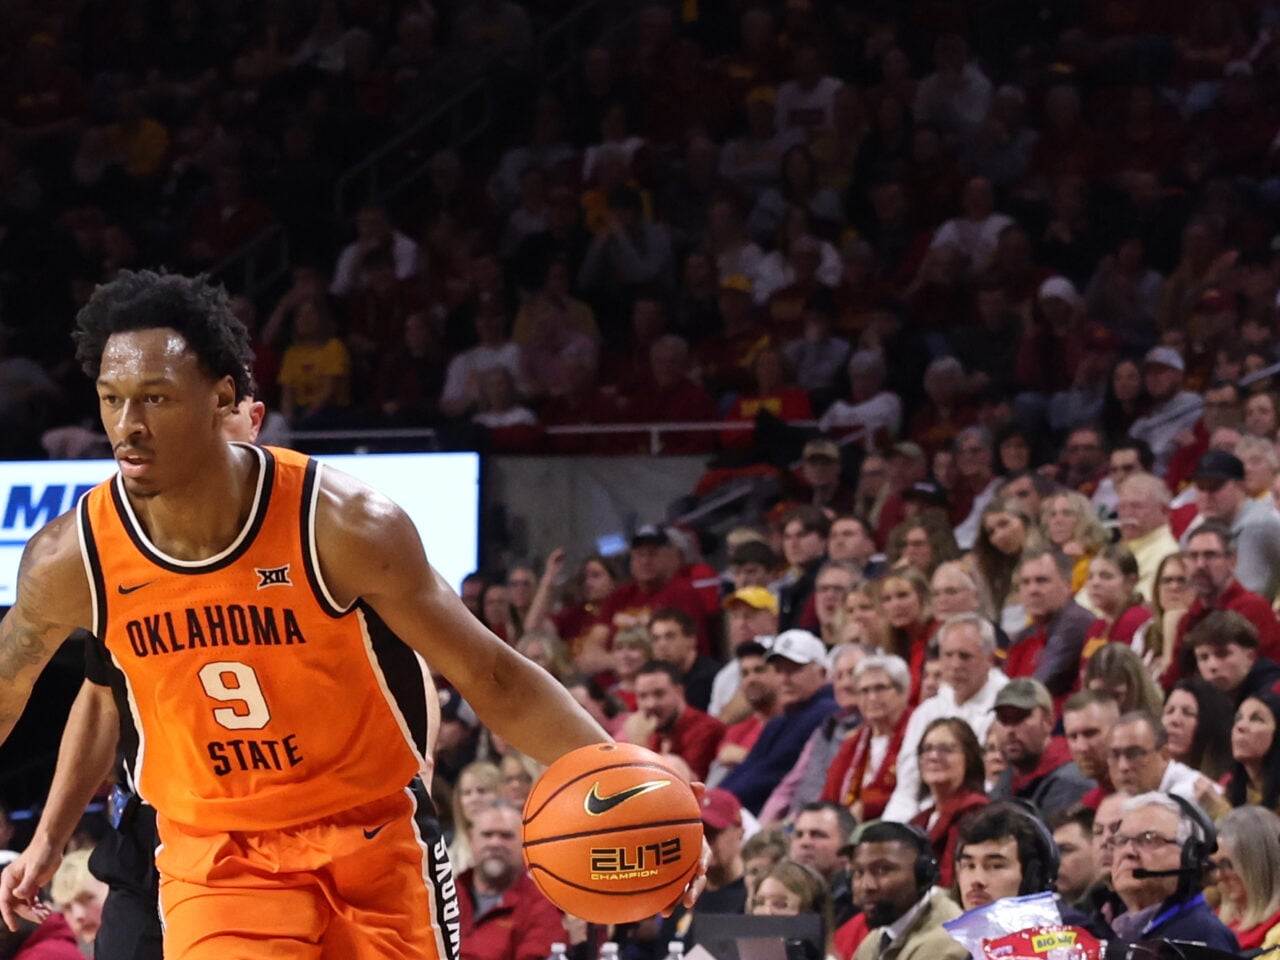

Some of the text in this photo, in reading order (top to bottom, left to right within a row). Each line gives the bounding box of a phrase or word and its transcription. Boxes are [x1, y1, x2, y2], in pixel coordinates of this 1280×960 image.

[256, 564, 292, 590] XII
[126, 604, 307, 658] OKLAHOMA
[197, 660, 272, 731] 9
[207, 733, 304, 777] STATE
[590, 836, 682, 873] ELITE
[590, 869, 659, 881] CHAMPION
